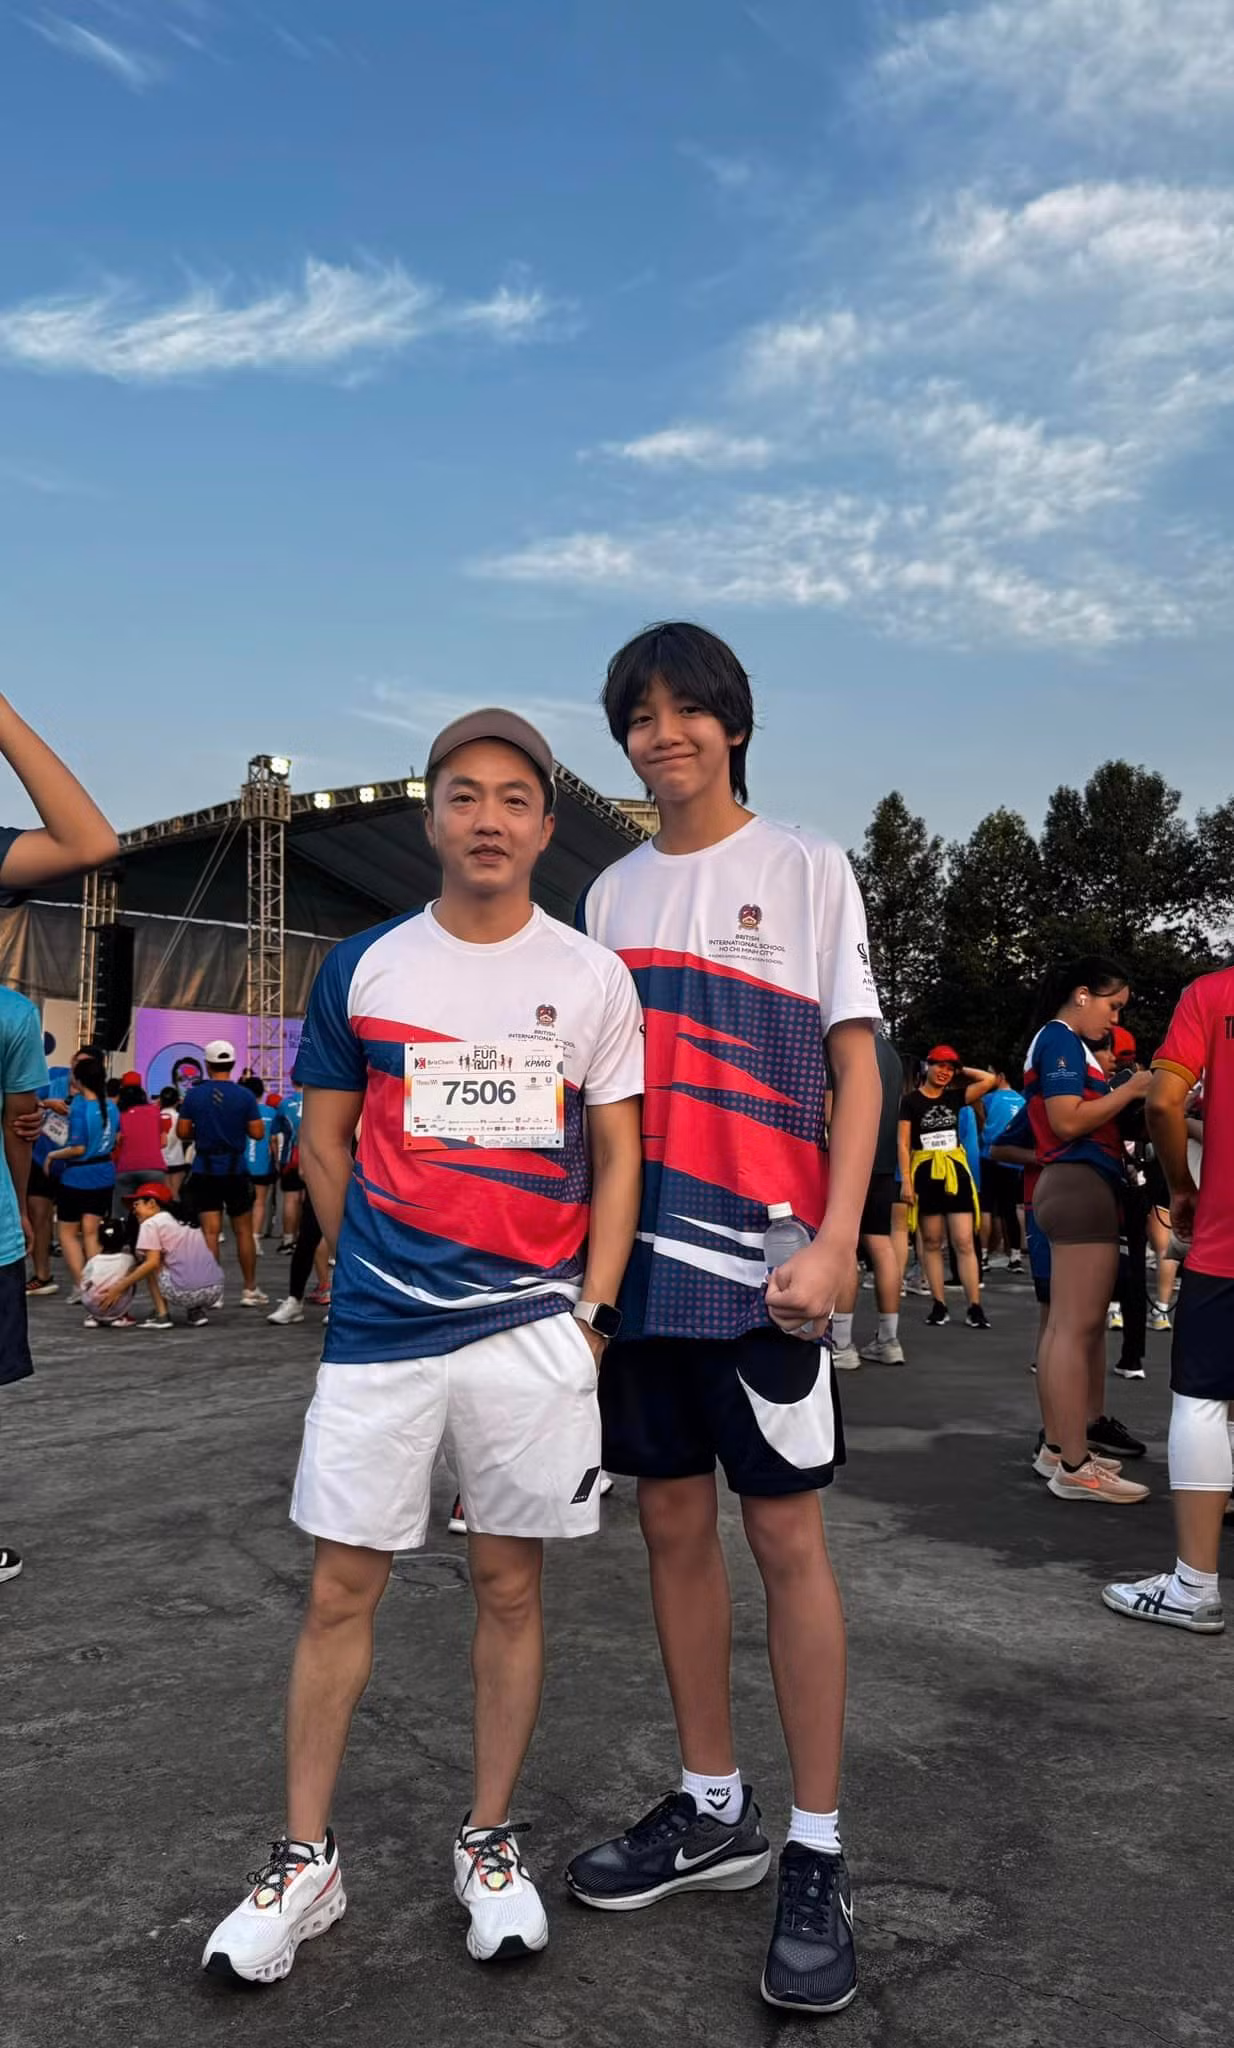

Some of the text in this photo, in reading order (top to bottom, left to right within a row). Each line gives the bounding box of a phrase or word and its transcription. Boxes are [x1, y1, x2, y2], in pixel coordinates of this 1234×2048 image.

[735, 934, 760, 942] BRITISH
[708, 939, 786, 952] INTERNATIONAL SCHOOL
[741, 947, 759, 955] MINH
[534, 1029, 556, 1037] BRITISH
[474, 1050, 497, 1060] FUN
[474, 1060, 497, 1070] RUN
[524, 1060, 552, 1068] KPMG
[442, 1080, 516, 1105] 7506
[706, 1786, 731, 1797] NICE
